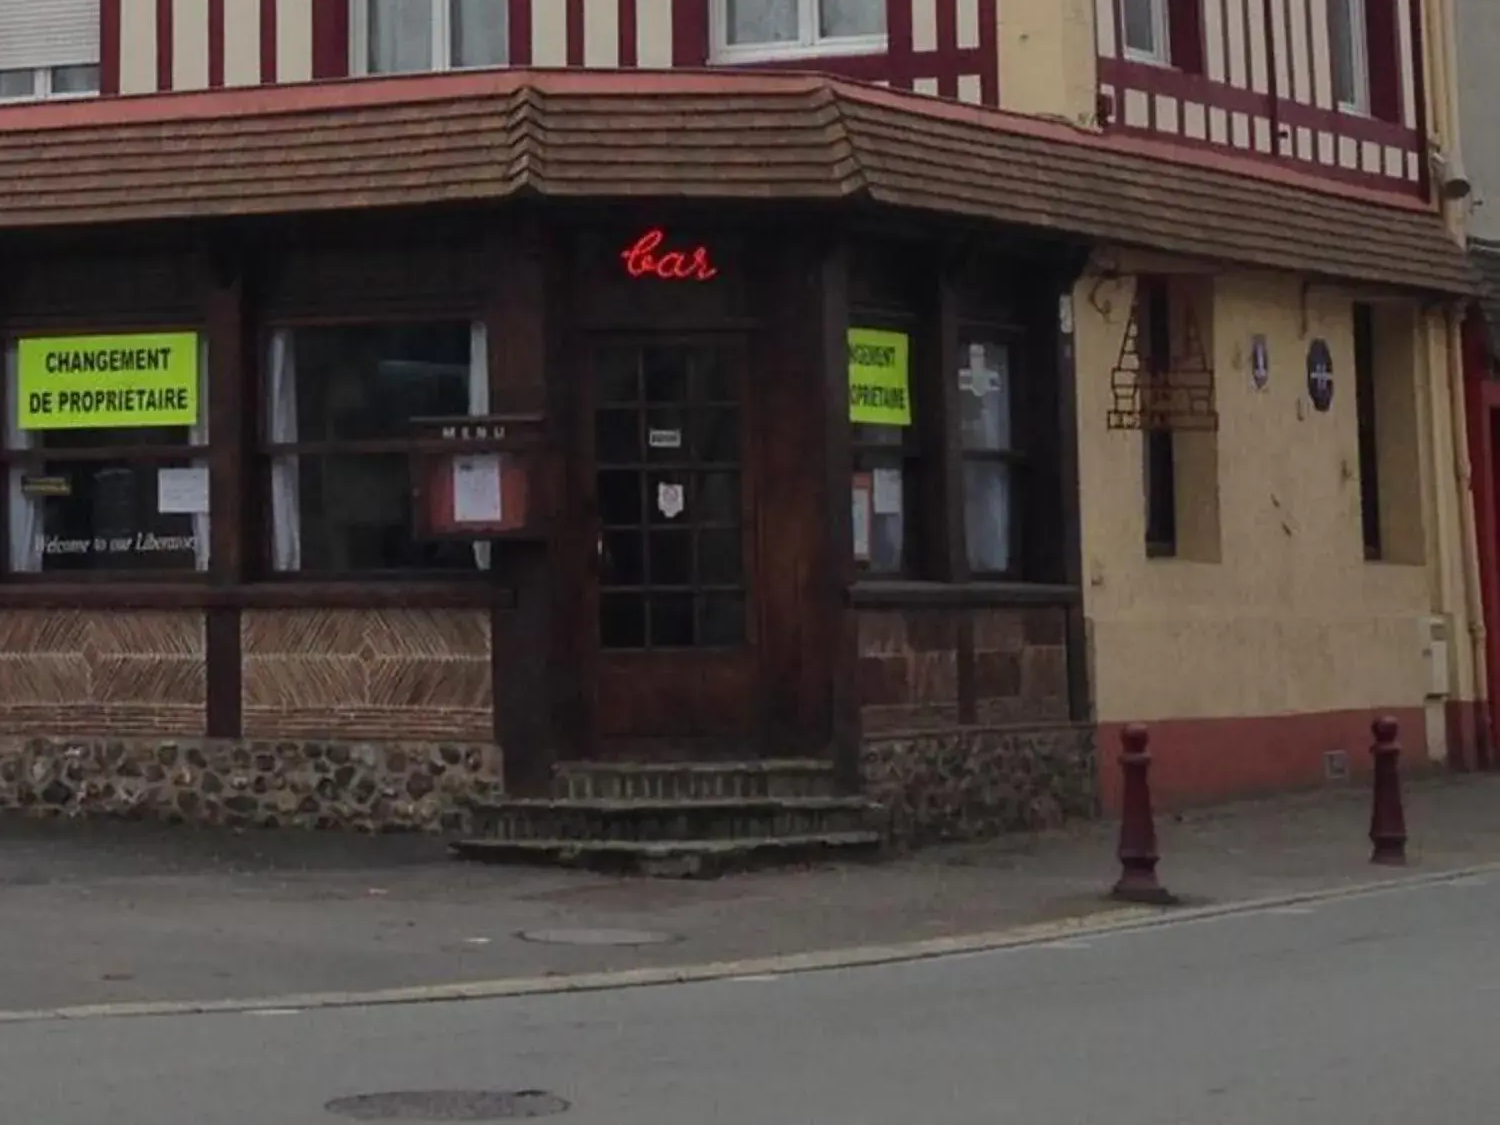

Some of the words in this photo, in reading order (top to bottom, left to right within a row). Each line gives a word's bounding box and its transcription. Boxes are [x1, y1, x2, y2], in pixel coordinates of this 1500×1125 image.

[620, 230, 718, 280] bar
[45, 347, 171, 373] CHANGEMENT
[29, 392, 53, 414] DE
[442, 426, 506, 440] MENU
[94, 537, 107, 552] to
